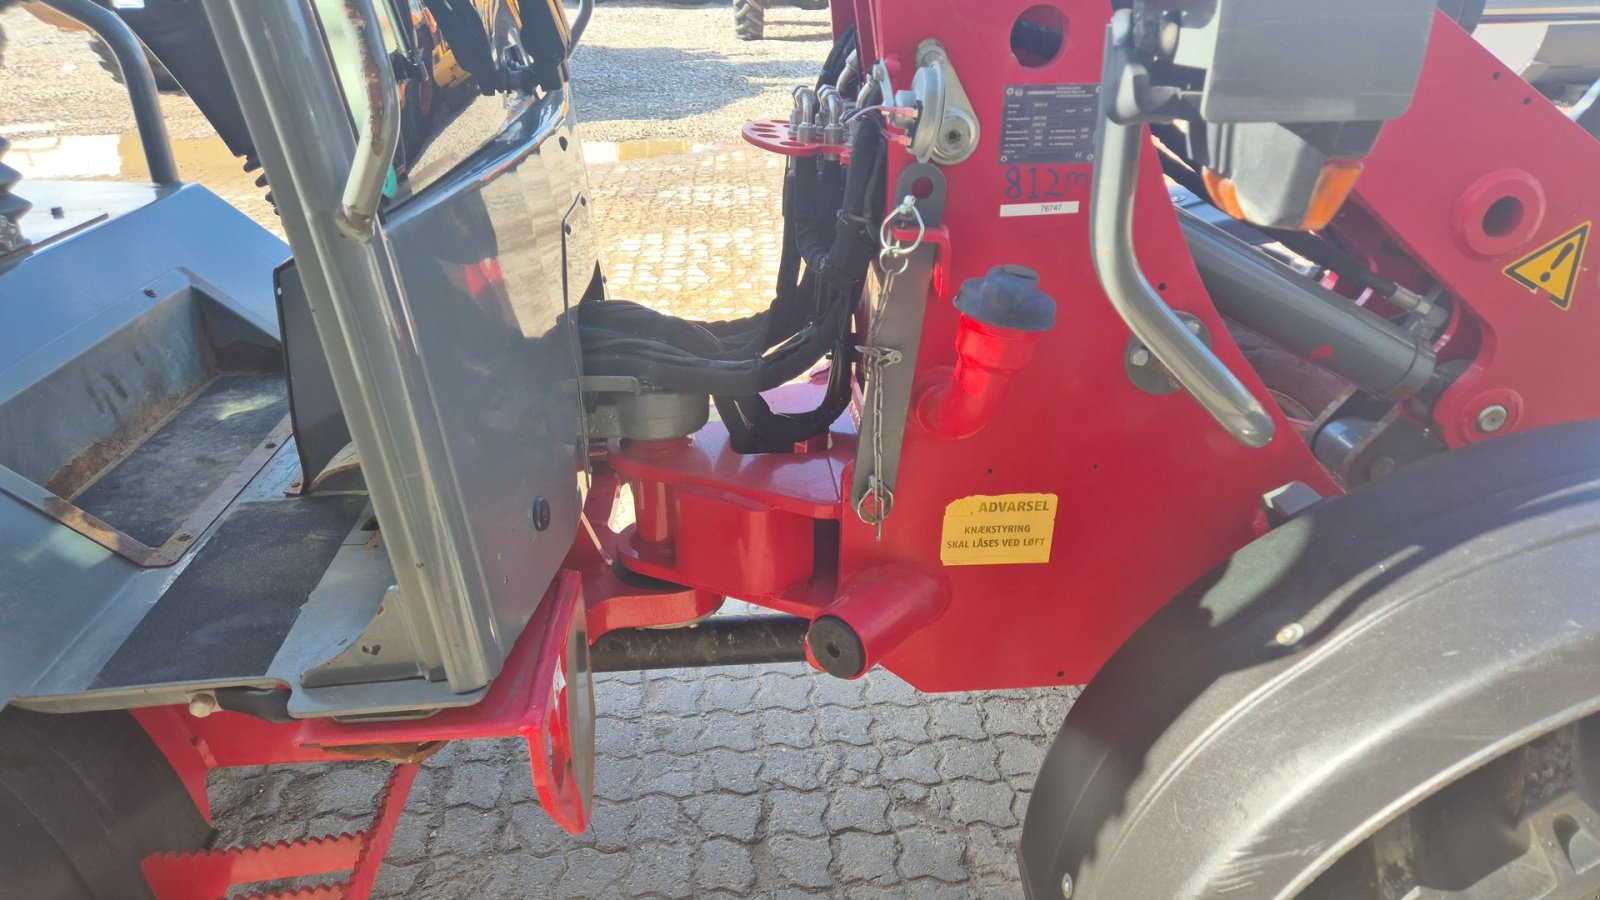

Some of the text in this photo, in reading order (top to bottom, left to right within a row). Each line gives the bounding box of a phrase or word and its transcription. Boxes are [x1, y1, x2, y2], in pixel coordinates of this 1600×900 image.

[1040, 204, 1062, 212] 76747
[978, 501, 1049, 513] ADVARSEL
[964, 525, 1030, 534] KNÆKSTYRING
[947, 538, 1045, 549] SKAL LÅSES VED LØFT
